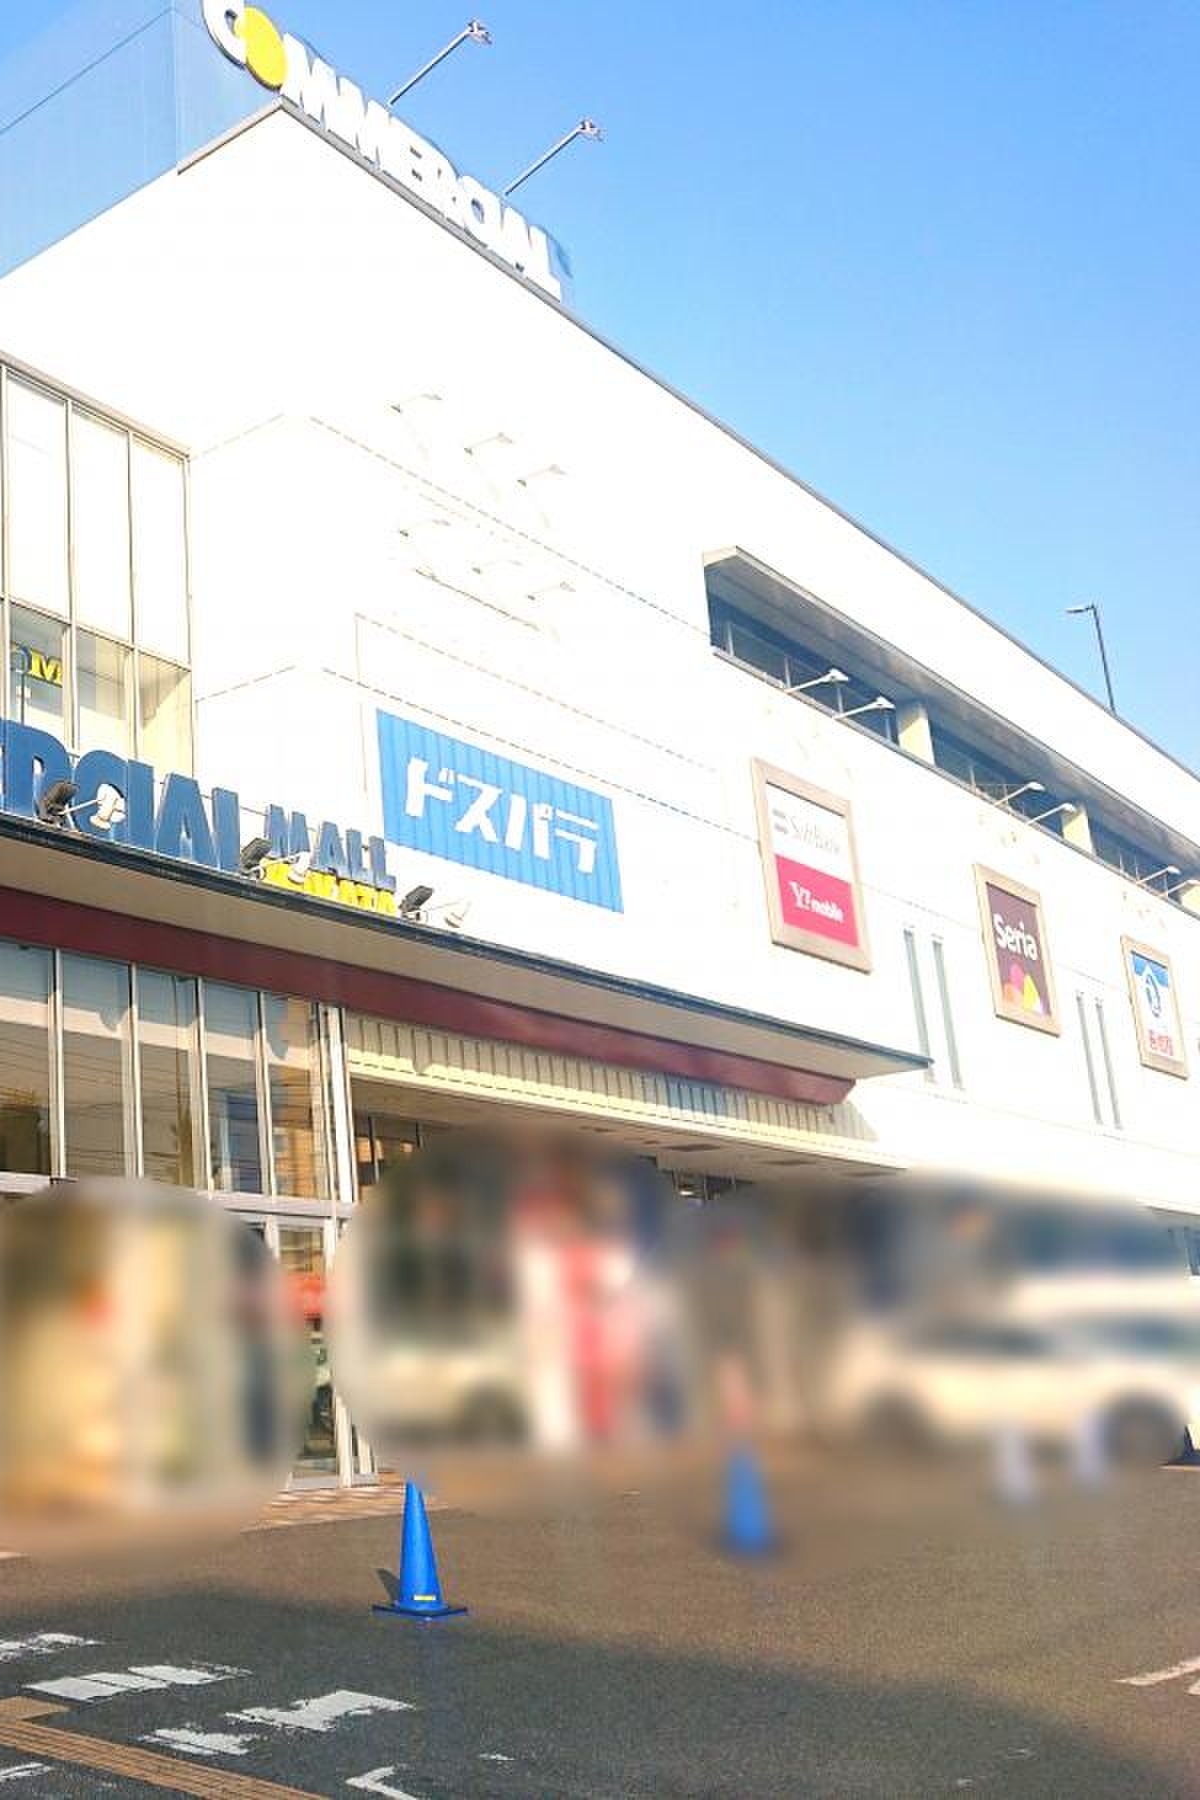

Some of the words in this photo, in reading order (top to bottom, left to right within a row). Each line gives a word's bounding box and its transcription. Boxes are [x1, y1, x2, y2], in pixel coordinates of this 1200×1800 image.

[201, 0, 562, 304] COMMERCIAL
[264, 803, 397, 894] MALL
[405, 756, 599, 874] ドスパラ
[993, 912, 1038, 961] Seria
